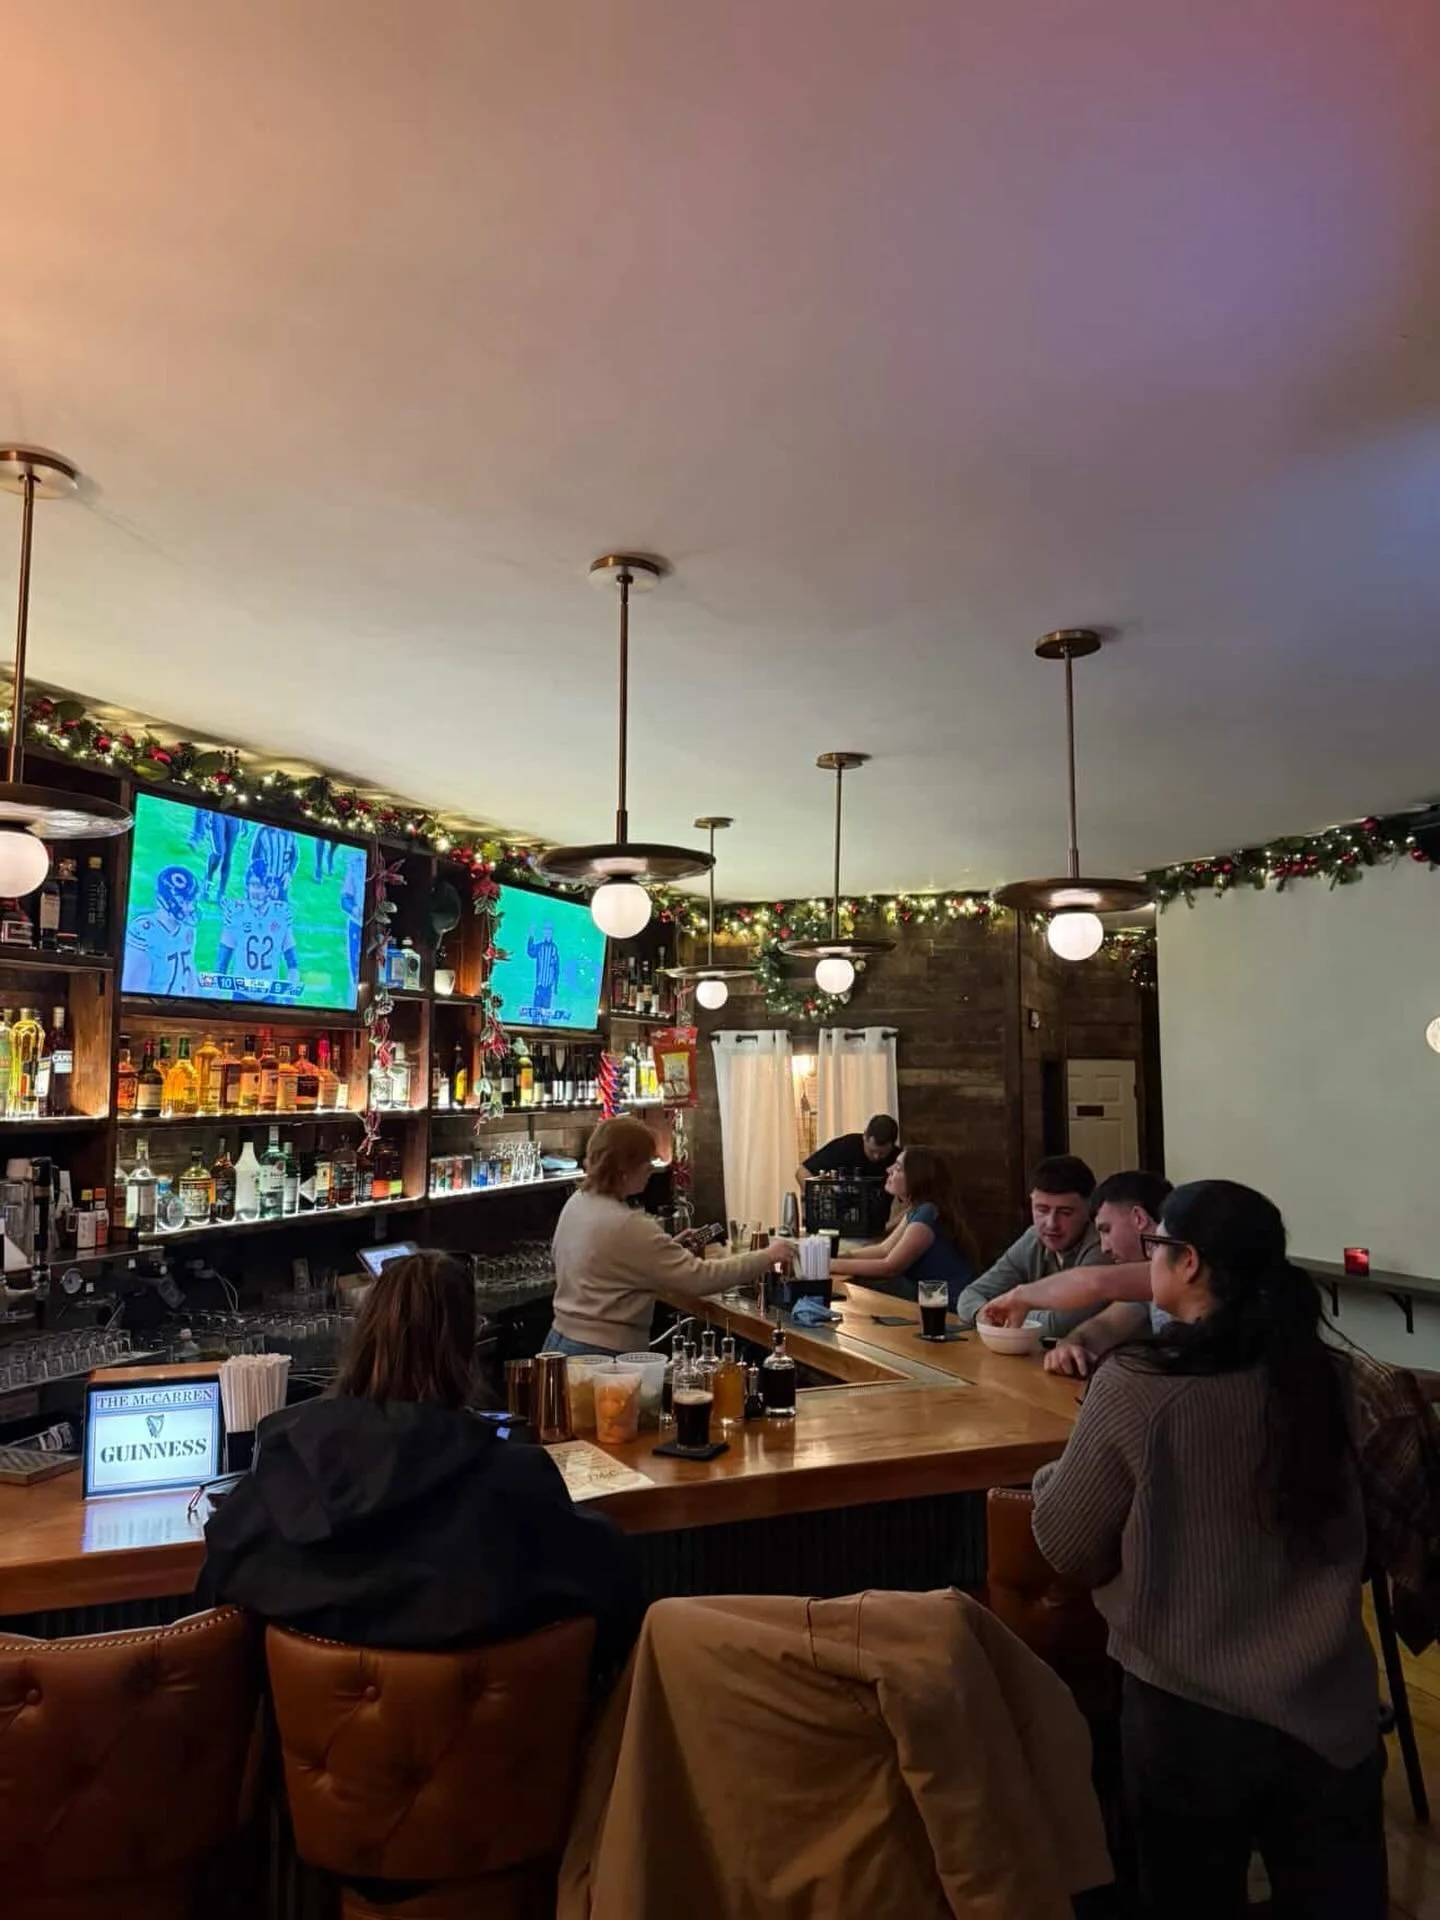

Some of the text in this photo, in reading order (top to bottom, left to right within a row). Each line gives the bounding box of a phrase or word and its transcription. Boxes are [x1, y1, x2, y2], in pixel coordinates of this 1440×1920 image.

[247, 935, 274, 971] 62
[97, 1397, 129, 1409] THE
[100, 1438, 208, 1464] GUINNESS
